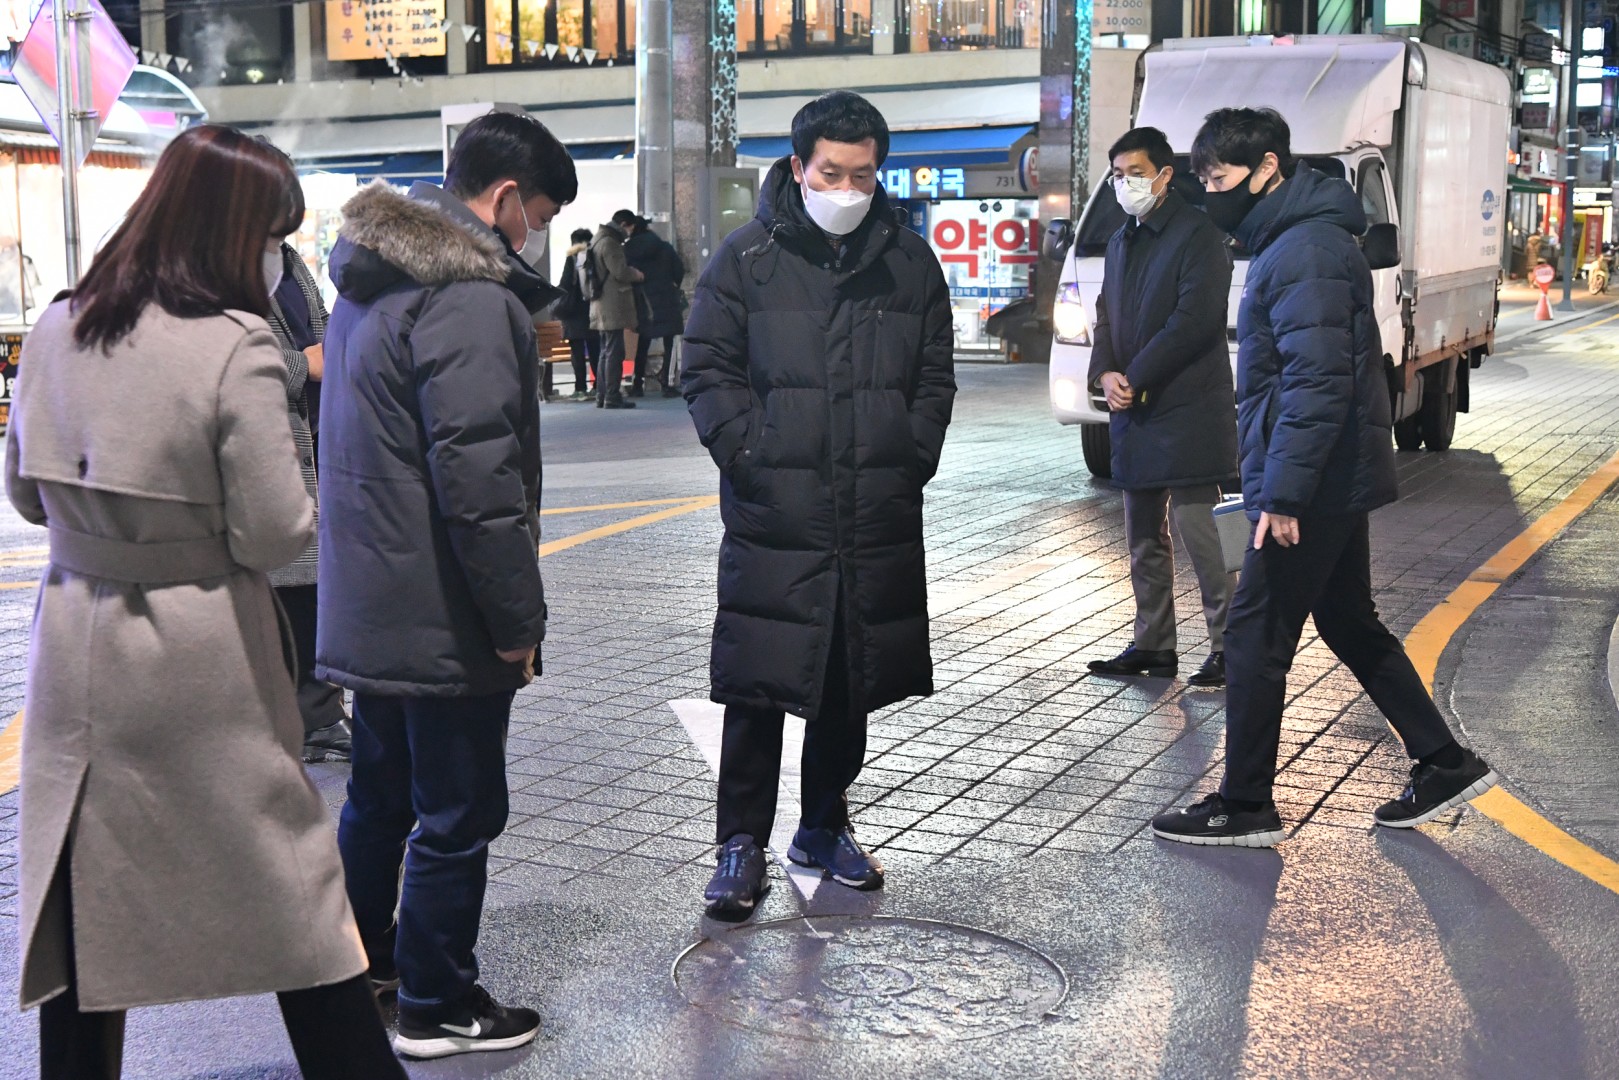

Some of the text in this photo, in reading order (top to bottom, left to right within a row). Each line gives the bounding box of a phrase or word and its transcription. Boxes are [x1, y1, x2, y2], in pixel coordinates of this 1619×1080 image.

[1106, 0, 1143, 8] 22,000
[1106, 17, 1143, 26] 10,000
[996, 176, 1015, 187] 731
[933, 219, 988, 278] 약
